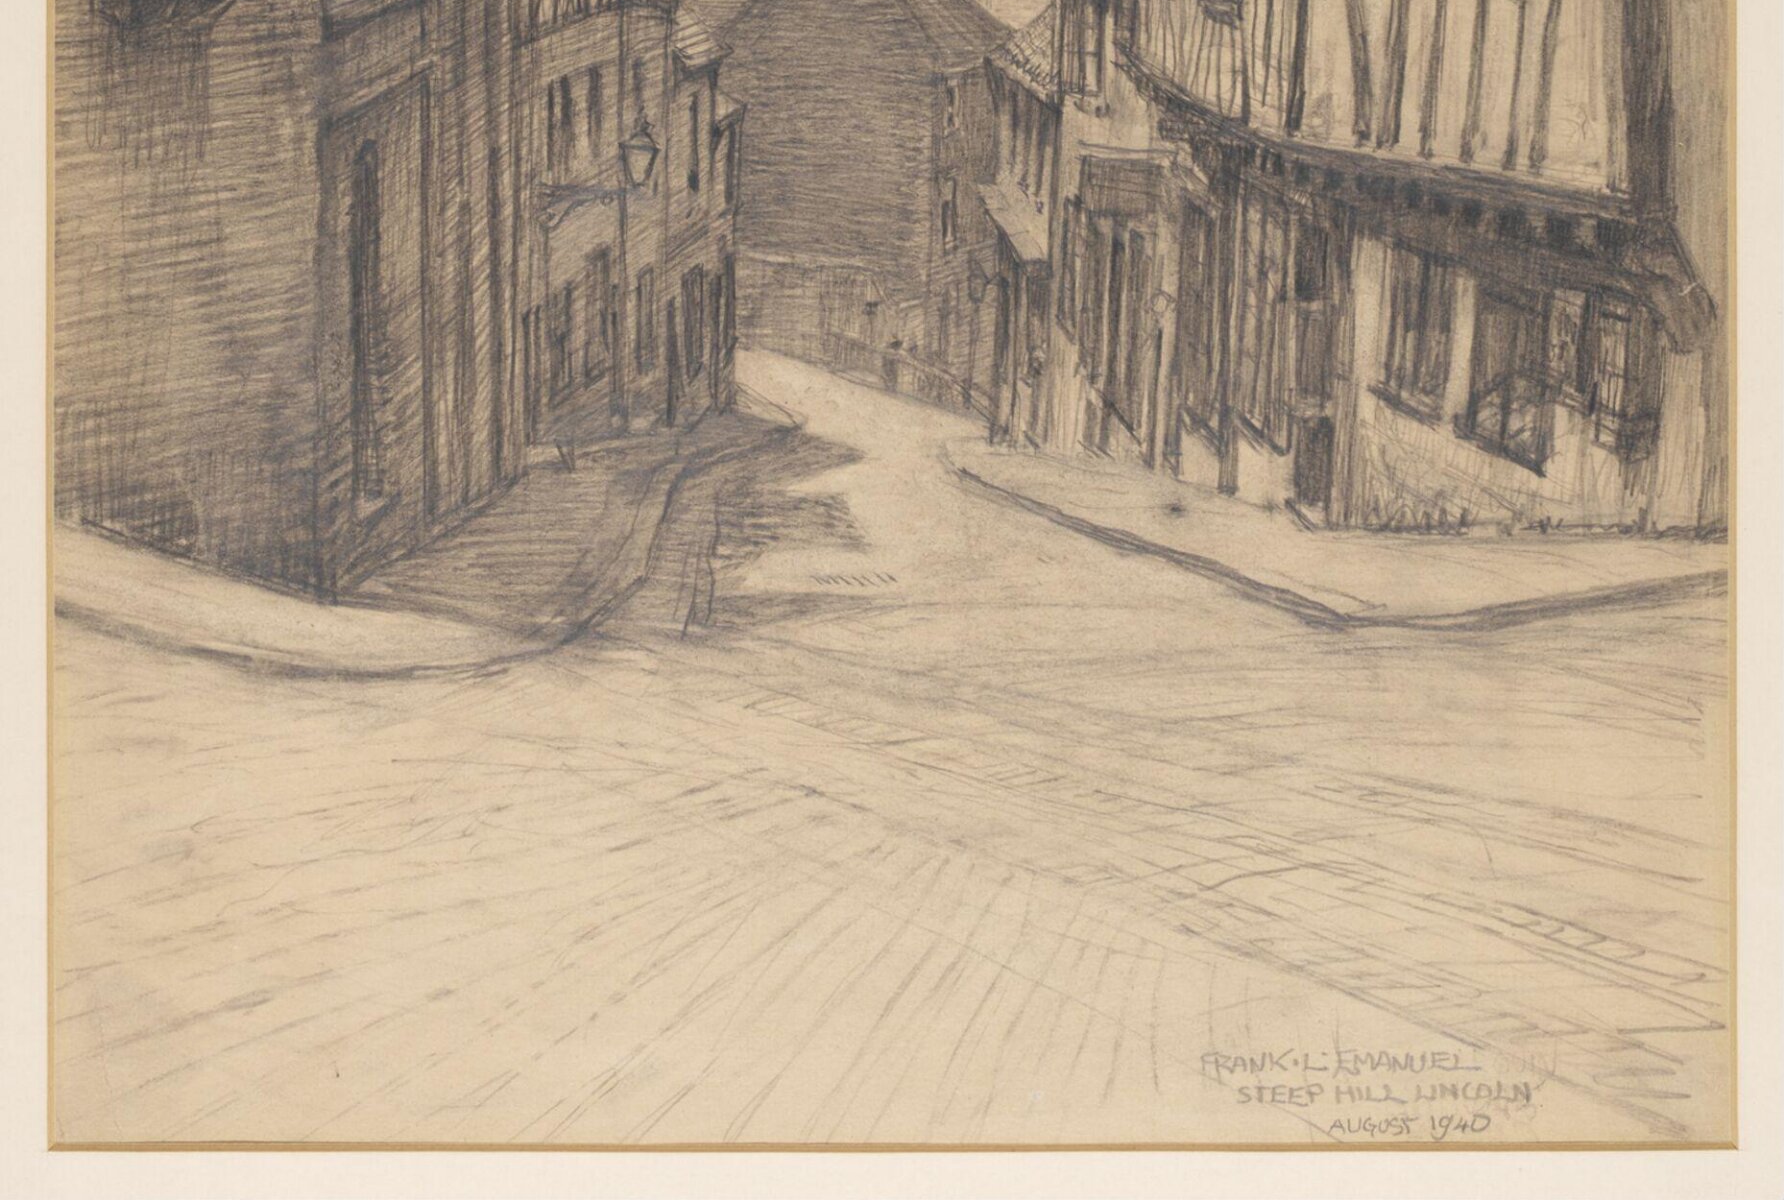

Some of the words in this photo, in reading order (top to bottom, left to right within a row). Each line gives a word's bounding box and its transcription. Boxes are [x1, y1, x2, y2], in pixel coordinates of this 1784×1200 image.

[1334, 1049, 1482, 1077] EMANUEL
[1237, 1083, 1325, 1107] STEEP
[1335, 1084, 1408, 1104] HILL
[1415, 1080, 1532, 1103] LINCOLN
[1328, 1116, 1419, 1137] AUGUST
[1430, 1113, 1491, 1140] 1940
